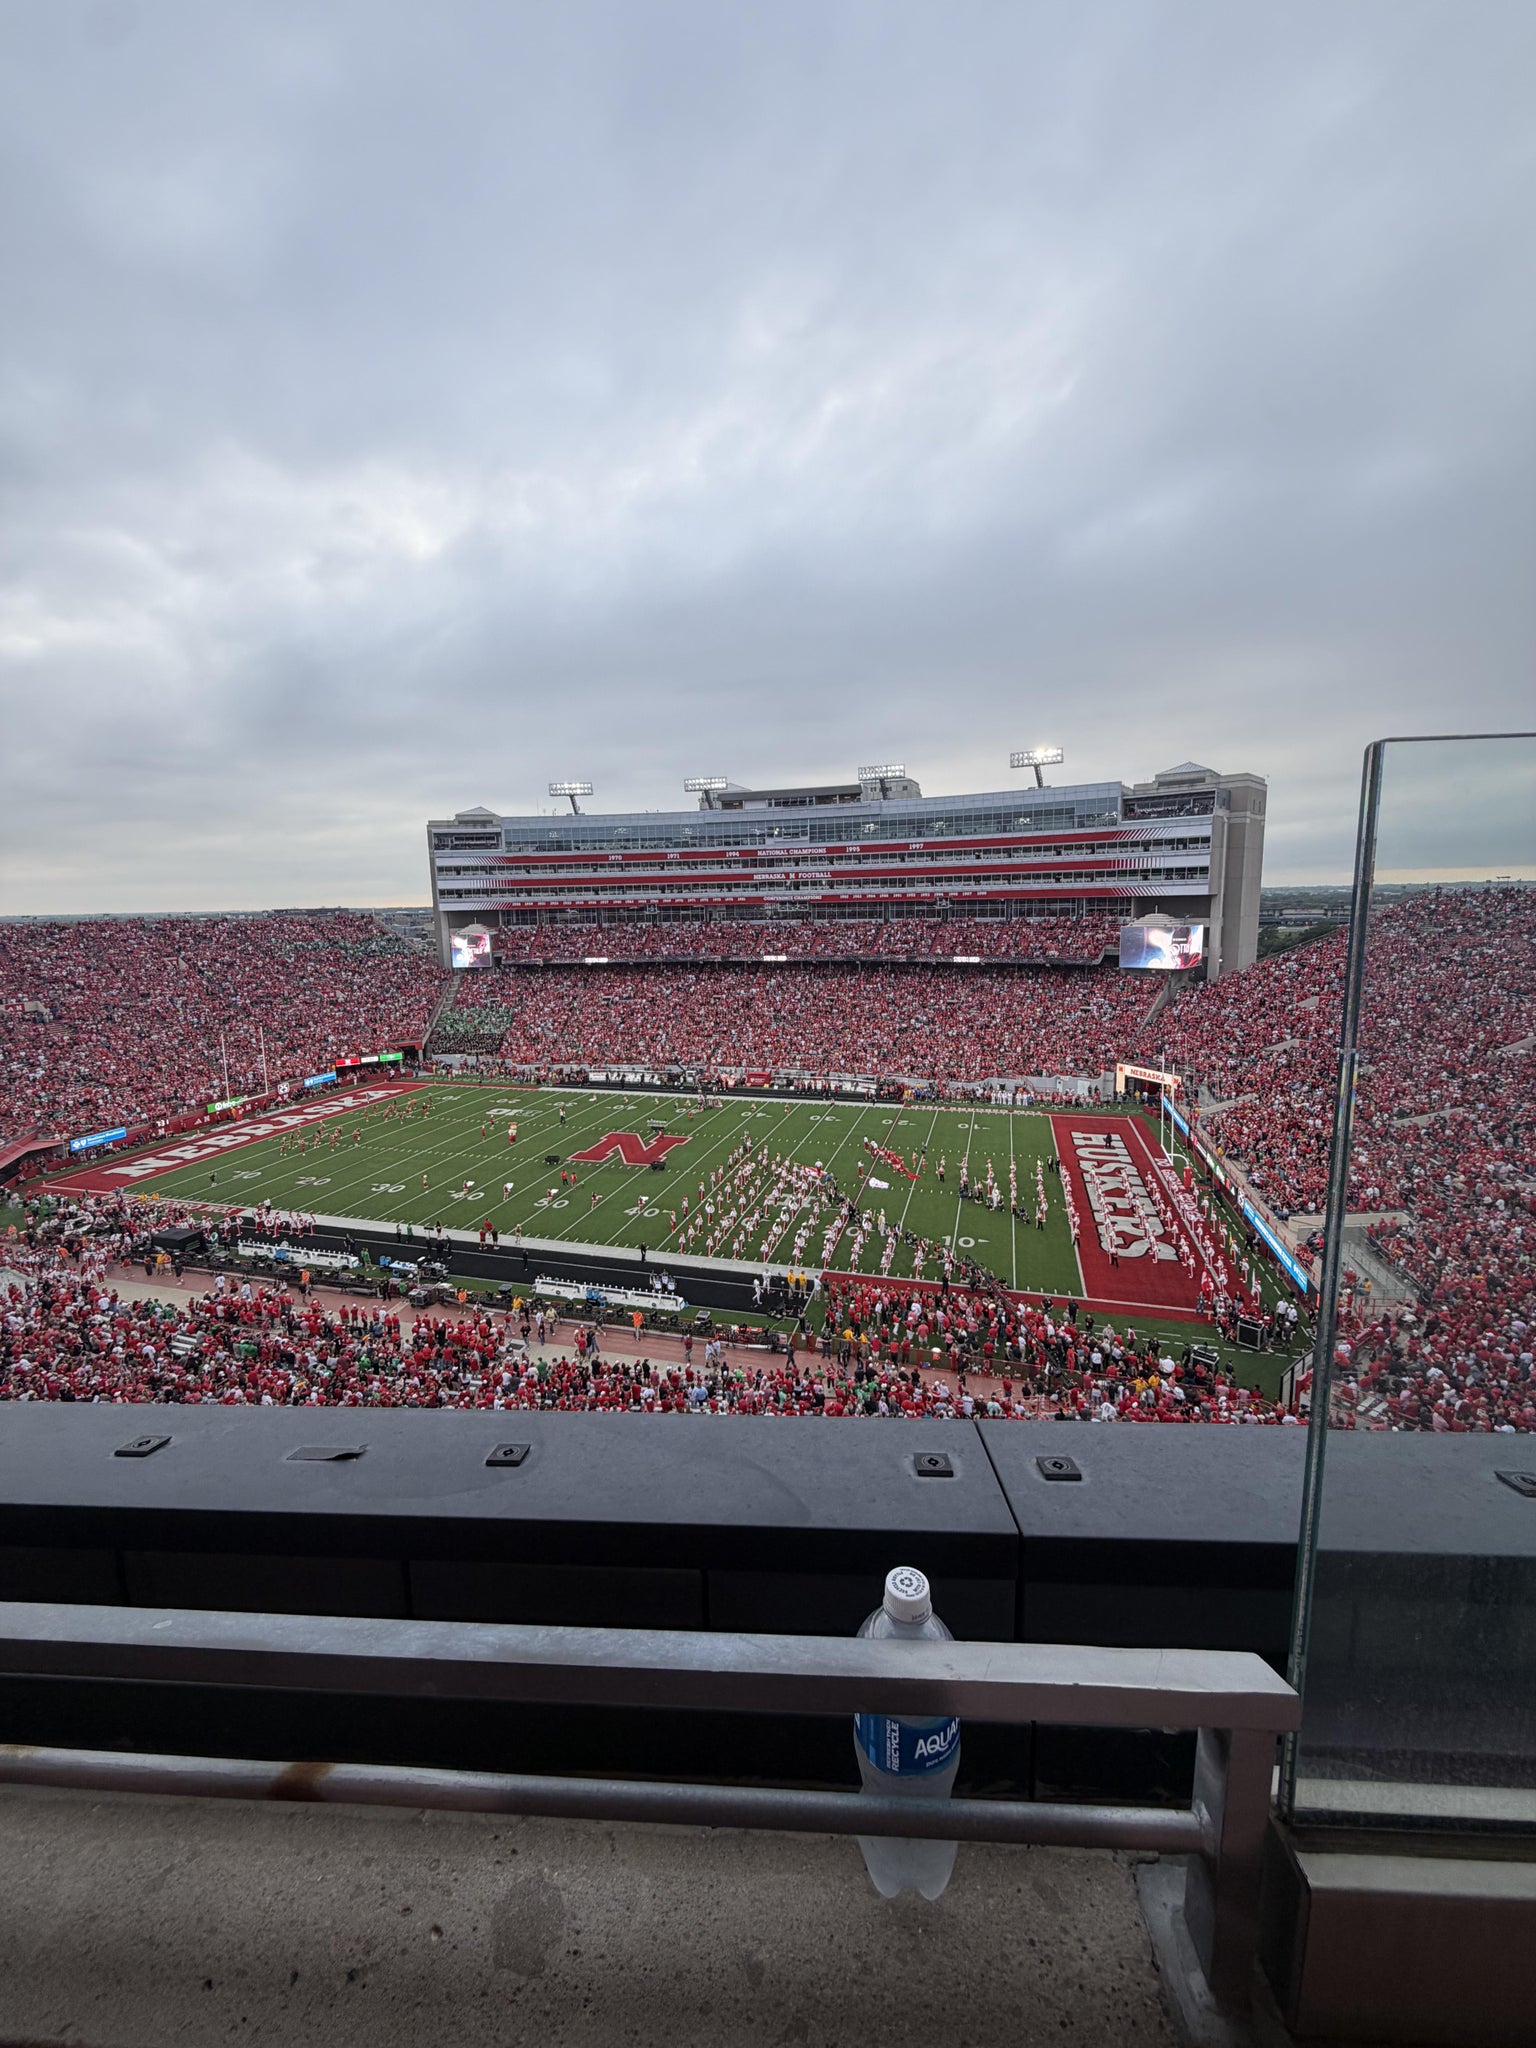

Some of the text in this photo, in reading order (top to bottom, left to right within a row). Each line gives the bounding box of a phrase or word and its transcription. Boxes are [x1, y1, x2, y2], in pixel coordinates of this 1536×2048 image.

[1130, 1068, 1166, 1082] NEBRASKA
[882, 1118, 912, 1126] 20
[101, 1088, 404, 1178] NEBRASKA
[566, 1132, 693, 1166] N
[296, 1176, 332, 1186] 20
[371, 1184, 406, 1193] 30
[533, 1196, 570, 1209] 50
[1070, 1131, 1180, 1261] HUSKERS
[624, 1206, 660, 1218] 40
[942, 1235, 976, 1248] 10
